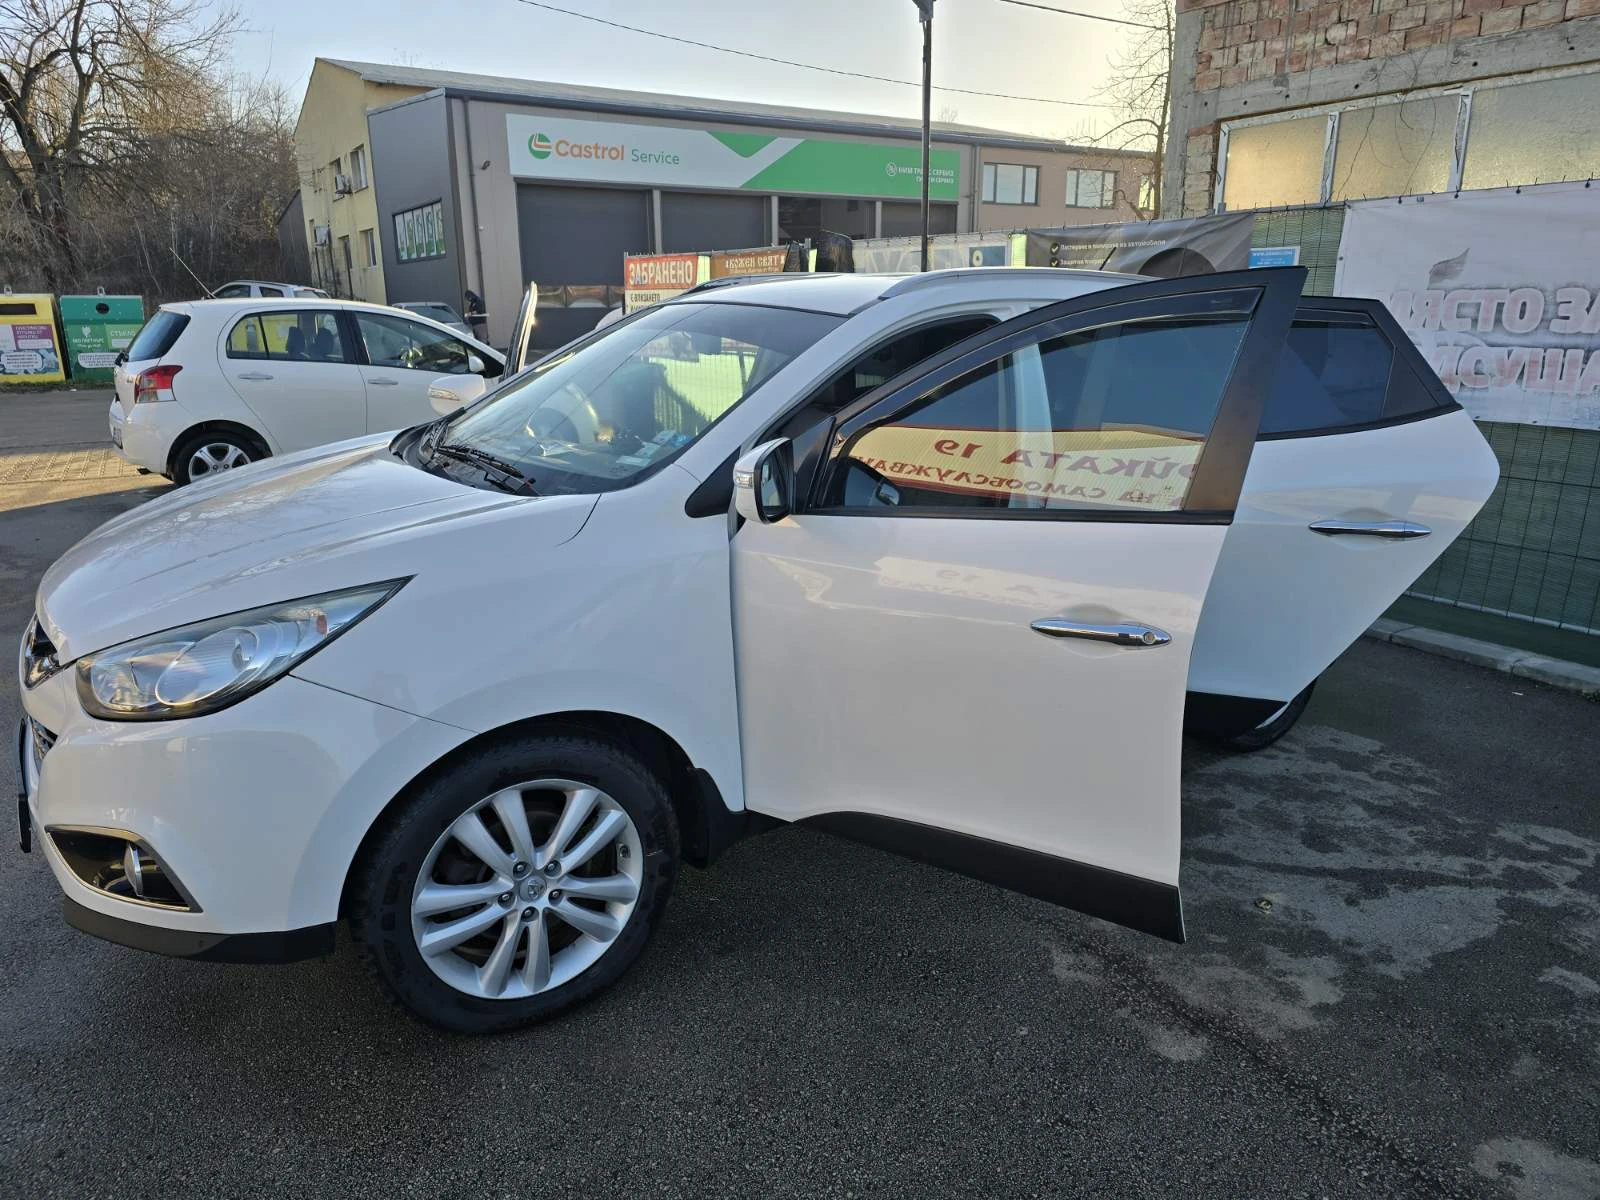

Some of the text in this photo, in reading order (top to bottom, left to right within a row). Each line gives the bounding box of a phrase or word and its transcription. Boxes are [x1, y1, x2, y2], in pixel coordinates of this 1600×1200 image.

[555, 139, 680, 165] Castrol Service
[629, 260, 694, 286] ЗАБРАНЕНО
